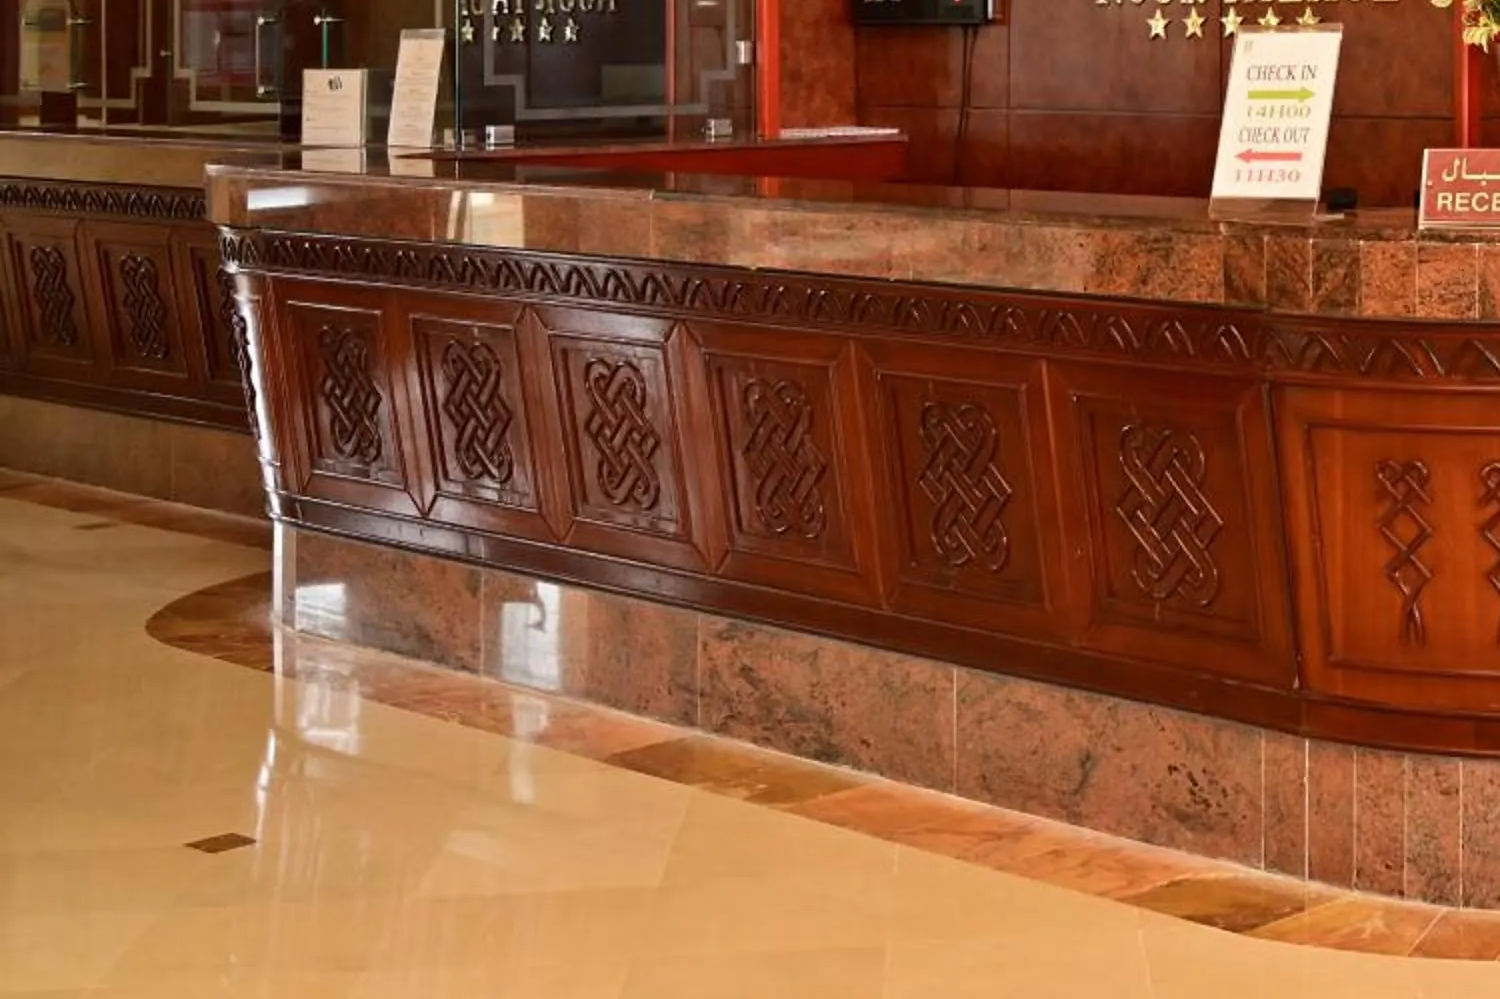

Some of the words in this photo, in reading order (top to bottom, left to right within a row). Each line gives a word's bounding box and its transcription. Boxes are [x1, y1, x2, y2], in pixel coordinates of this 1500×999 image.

[1246, 64, 1298, 81] CHECK
[1301, 64, 1318, 81] IN
[1238, 126, 1280, 144] CHECK
[1283, 126, 1311, 143] OUT
